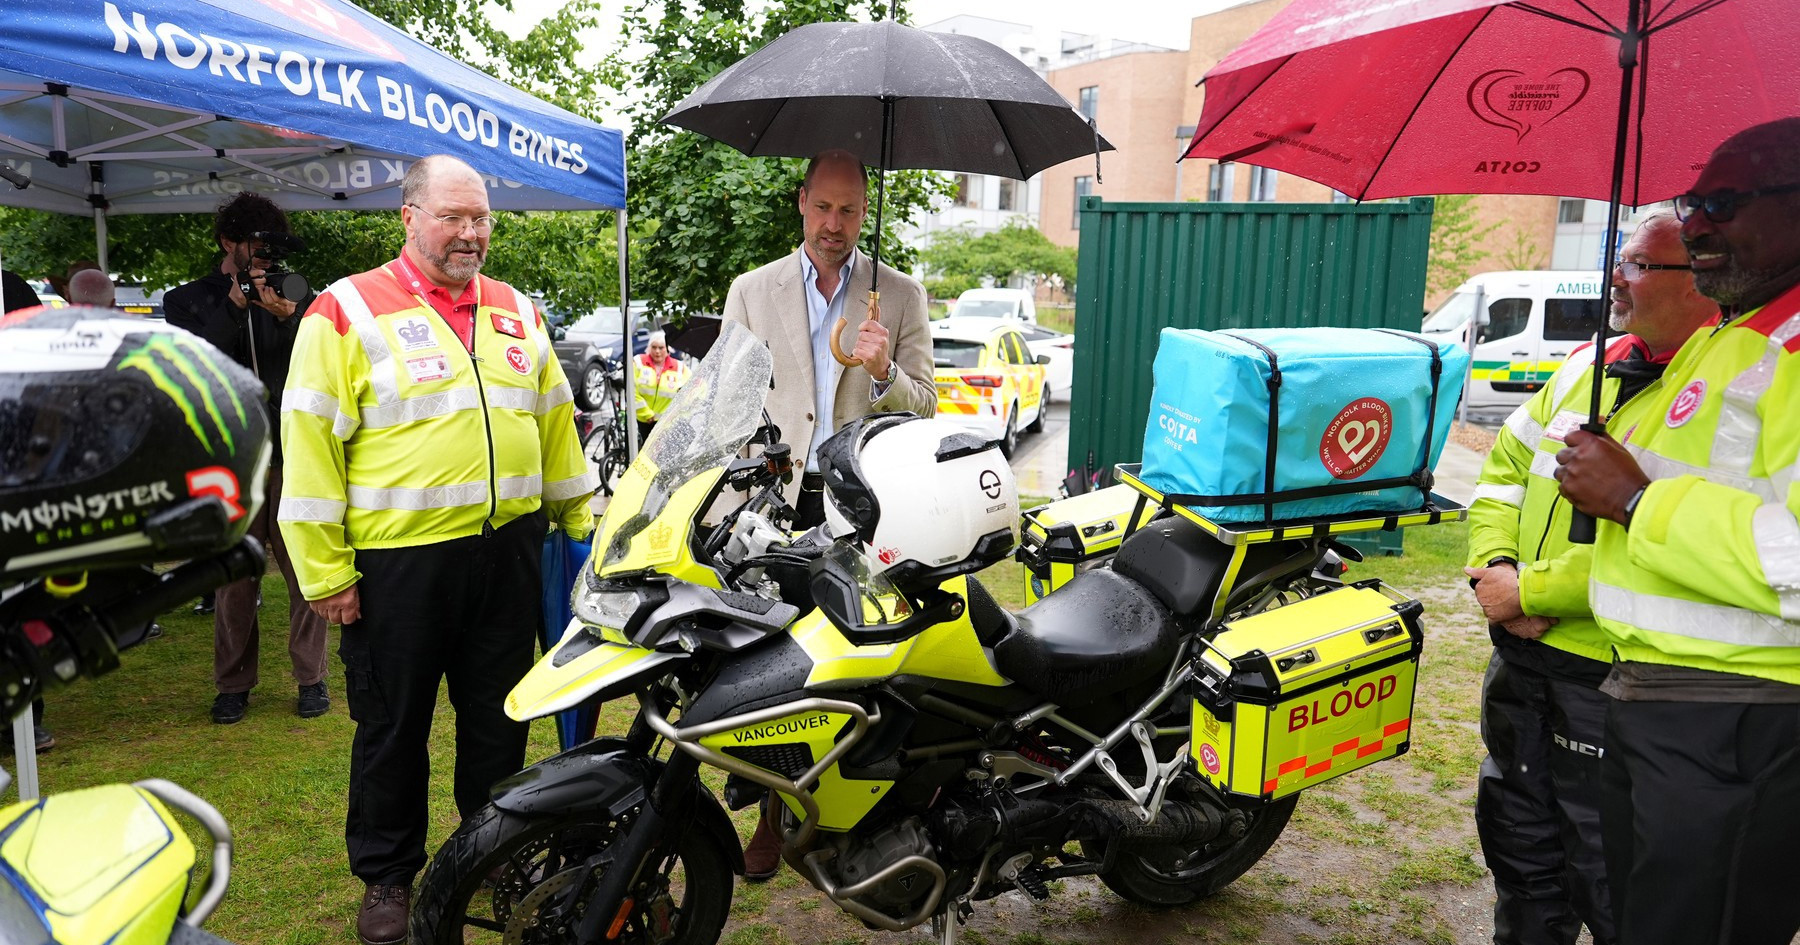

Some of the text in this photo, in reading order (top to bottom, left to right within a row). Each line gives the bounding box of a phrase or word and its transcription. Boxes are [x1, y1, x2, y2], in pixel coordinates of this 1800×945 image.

[104, 2, 589, 175] NORFOLK BLOOD BIKES
[1556, 282, 1603, 295] AMBU
[1159, 414, 1198, 444] COSTA
[1327, 404, 1359, 438] NORFOLK
[1361, 402, 1385, 414] BLOOD
[1323, 447, 1334, 469] WE'LL
[0, 480, 175, 533] MONSTER
[35, 512, 148, 545] ENERG
[1287, 674, 1397, 734] BLOOD
[733, 714, 830, 743] VANCOUVER
